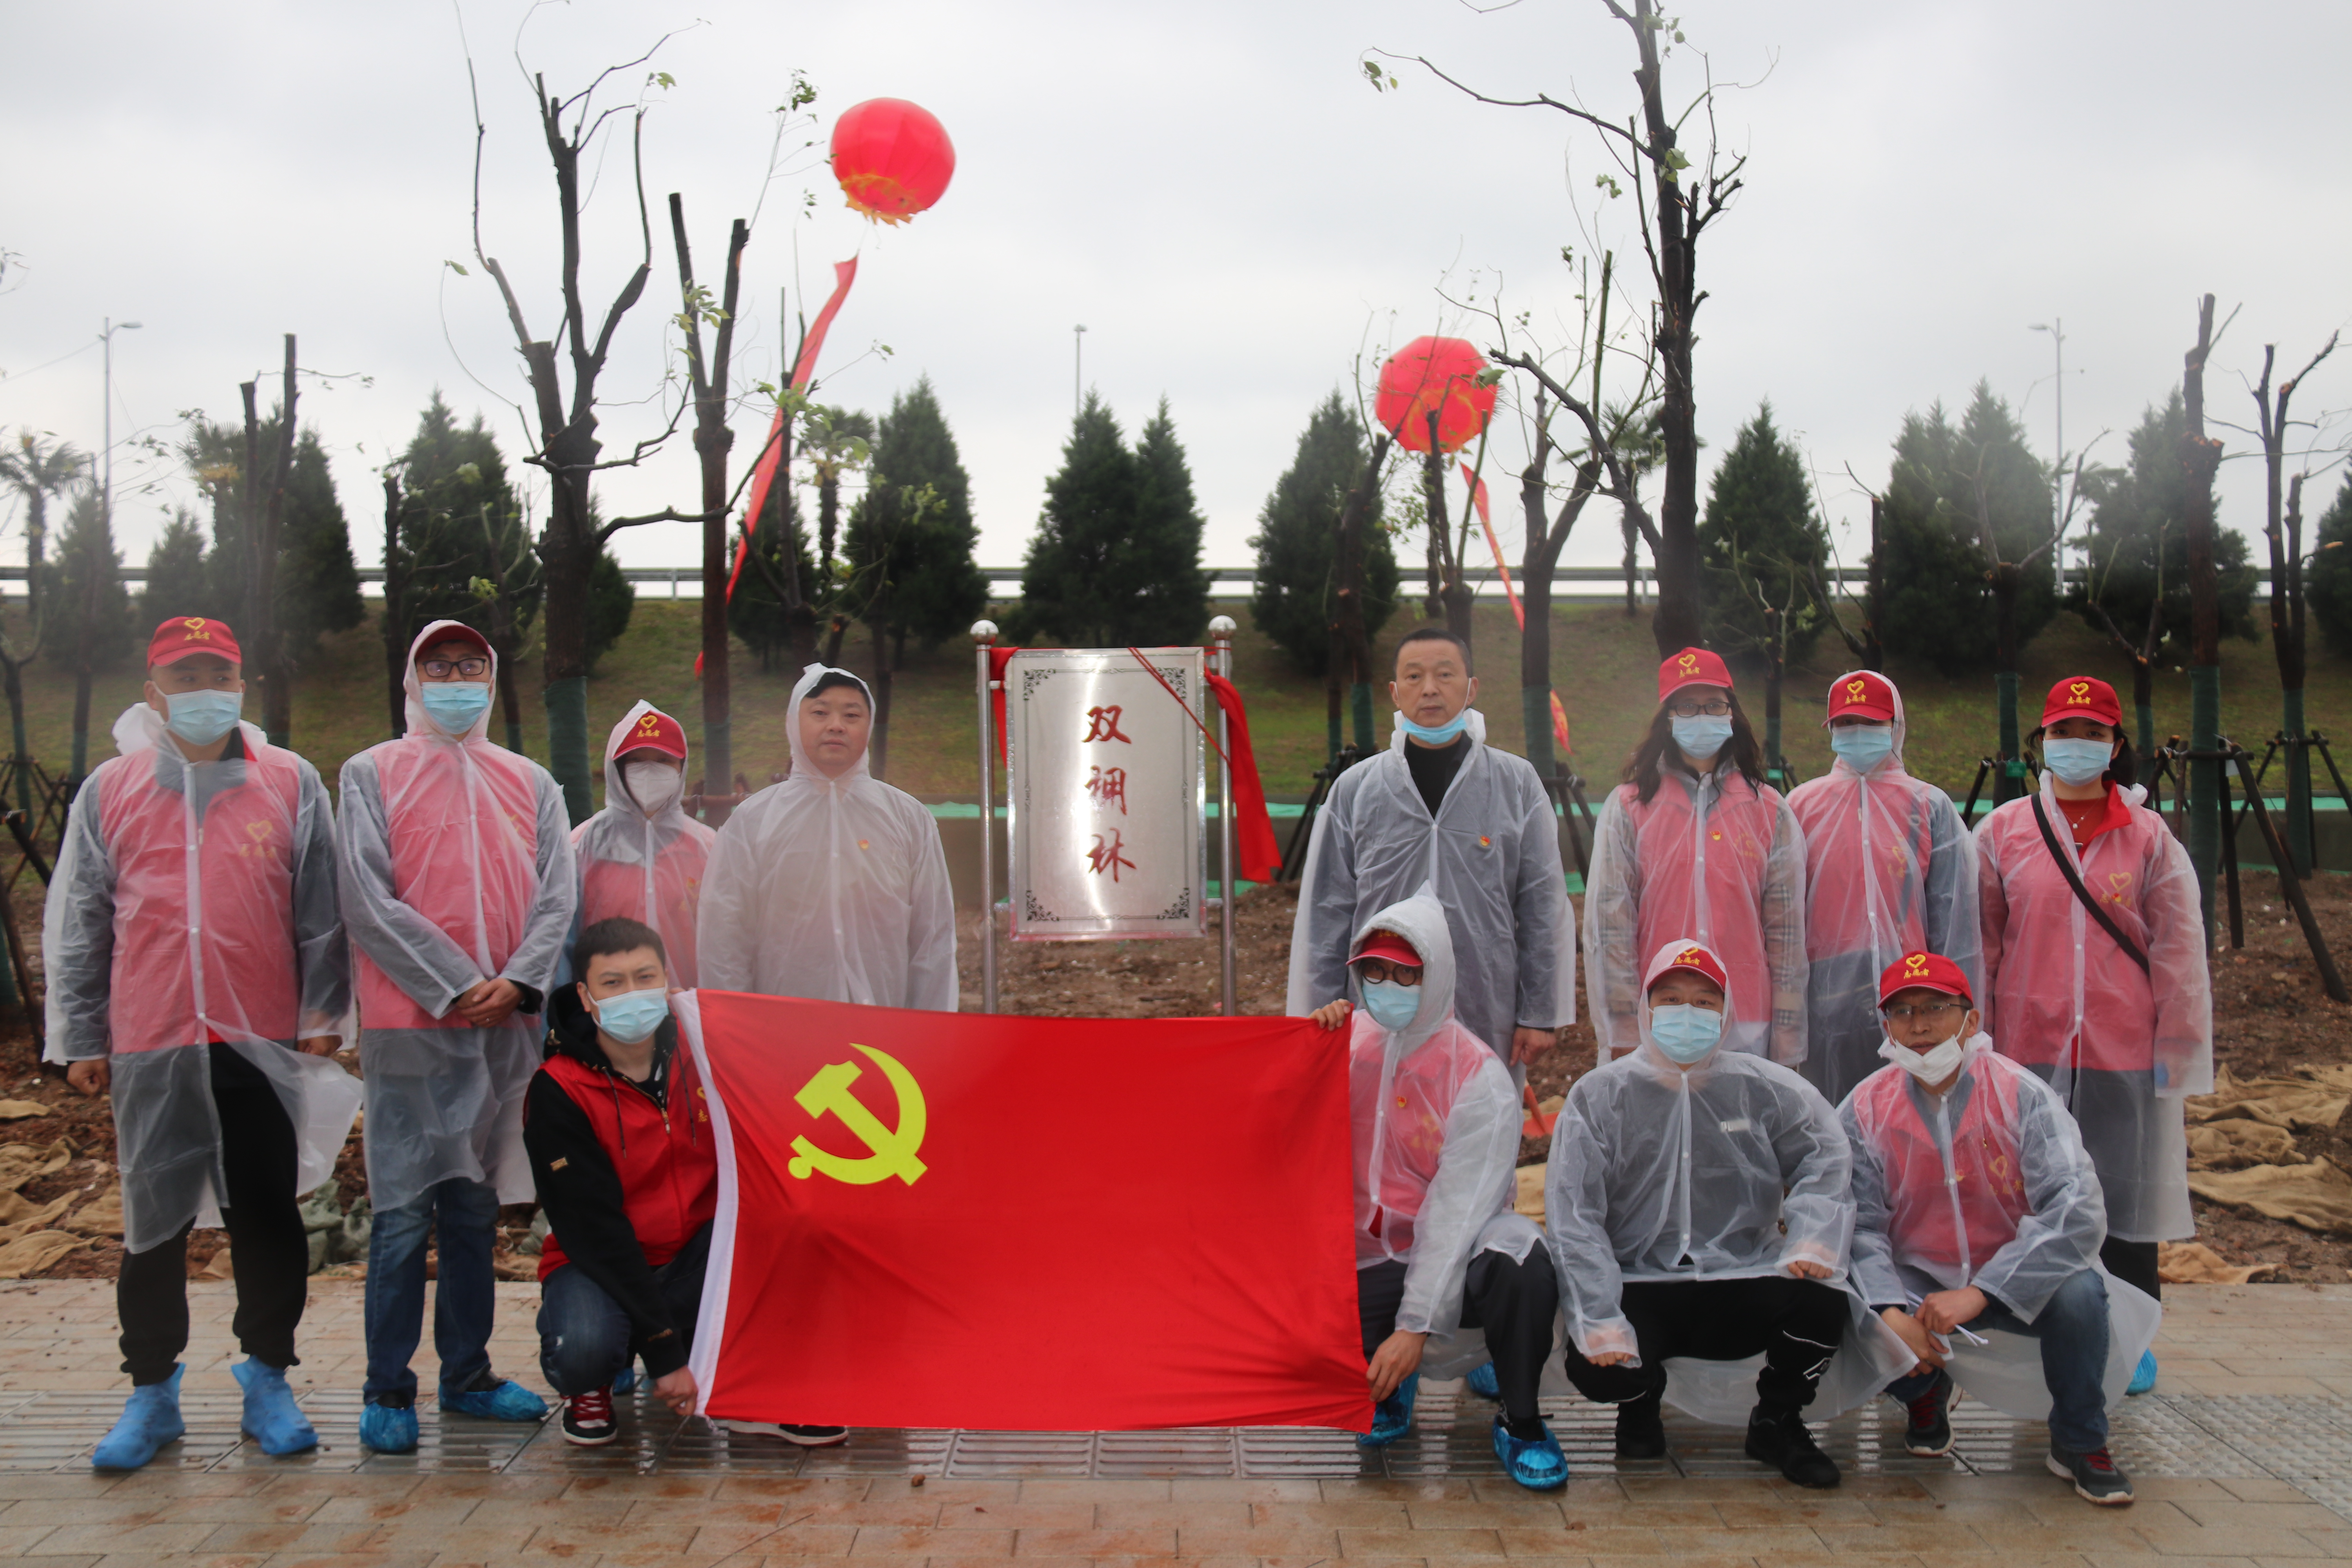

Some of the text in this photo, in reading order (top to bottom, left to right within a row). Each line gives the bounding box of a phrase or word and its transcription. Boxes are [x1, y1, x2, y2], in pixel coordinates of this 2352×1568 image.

[1679, 666, 1700, 678] 志愿者
[1845, 693, 1866, 704] 志愿者
[2067, 696, 2091, 705] 志愿者
[637, 729, 661, 737] 志愿者
[1675, 956, 1700, 965] 志愿者
[1903, 968, 1930, 980] 志愿者
